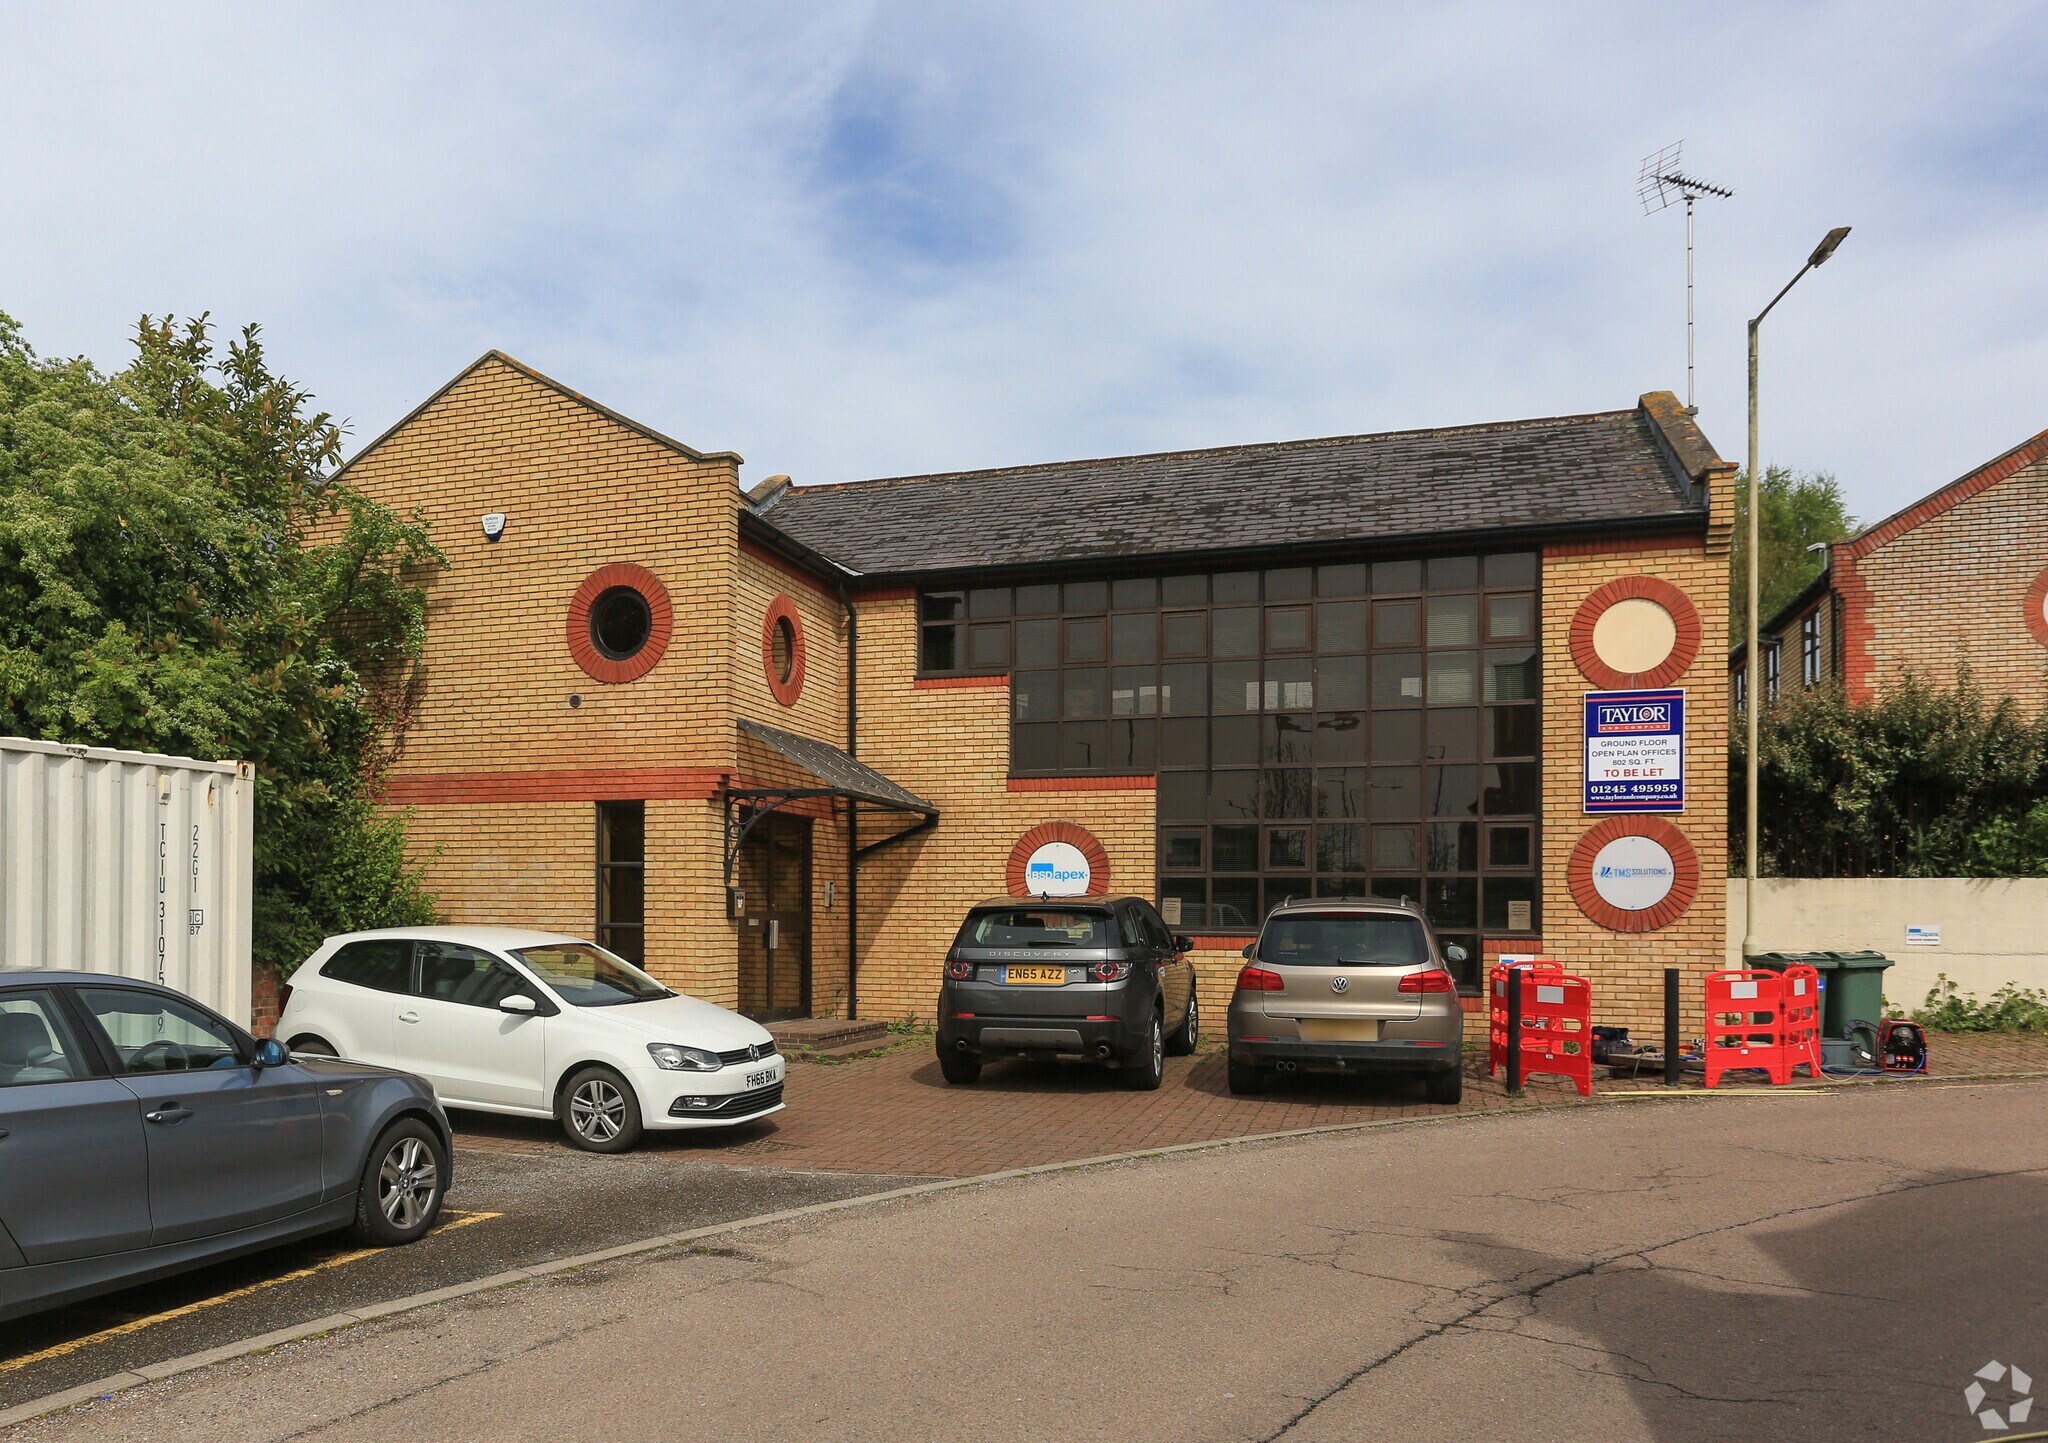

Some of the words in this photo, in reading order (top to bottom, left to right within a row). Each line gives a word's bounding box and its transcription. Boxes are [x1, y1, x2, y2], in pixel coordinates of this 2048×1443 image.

[1601, 706, 1667, 723] TAYLOR
[1617, 749, 1639, 757] PLAN
[1640, 748, 1677, 756] OFFICES
[1603, 769, 1620, 778] TO
[1623, 768, 1639, 777] BE
[1642, 767, 1664, 777] LET
[1590, 785, 1626, 794] 01245
[1630, 783, 1678, 793] 495959
[1590, 793, 1678, 801] www.taylorandcompany.co.uk
[1613, 868, 1632, 878] TMS
[1631, 868, 1667, 876] SOLUTIONS
[189, 926, 200, 935] 87
[1008, 968, 1037, 979] EN65
[1040, 969, 1062, 980] AZZ
[746, 1072, 765, 1088] FH66
[765, 1068, 777, 1084] BKA
